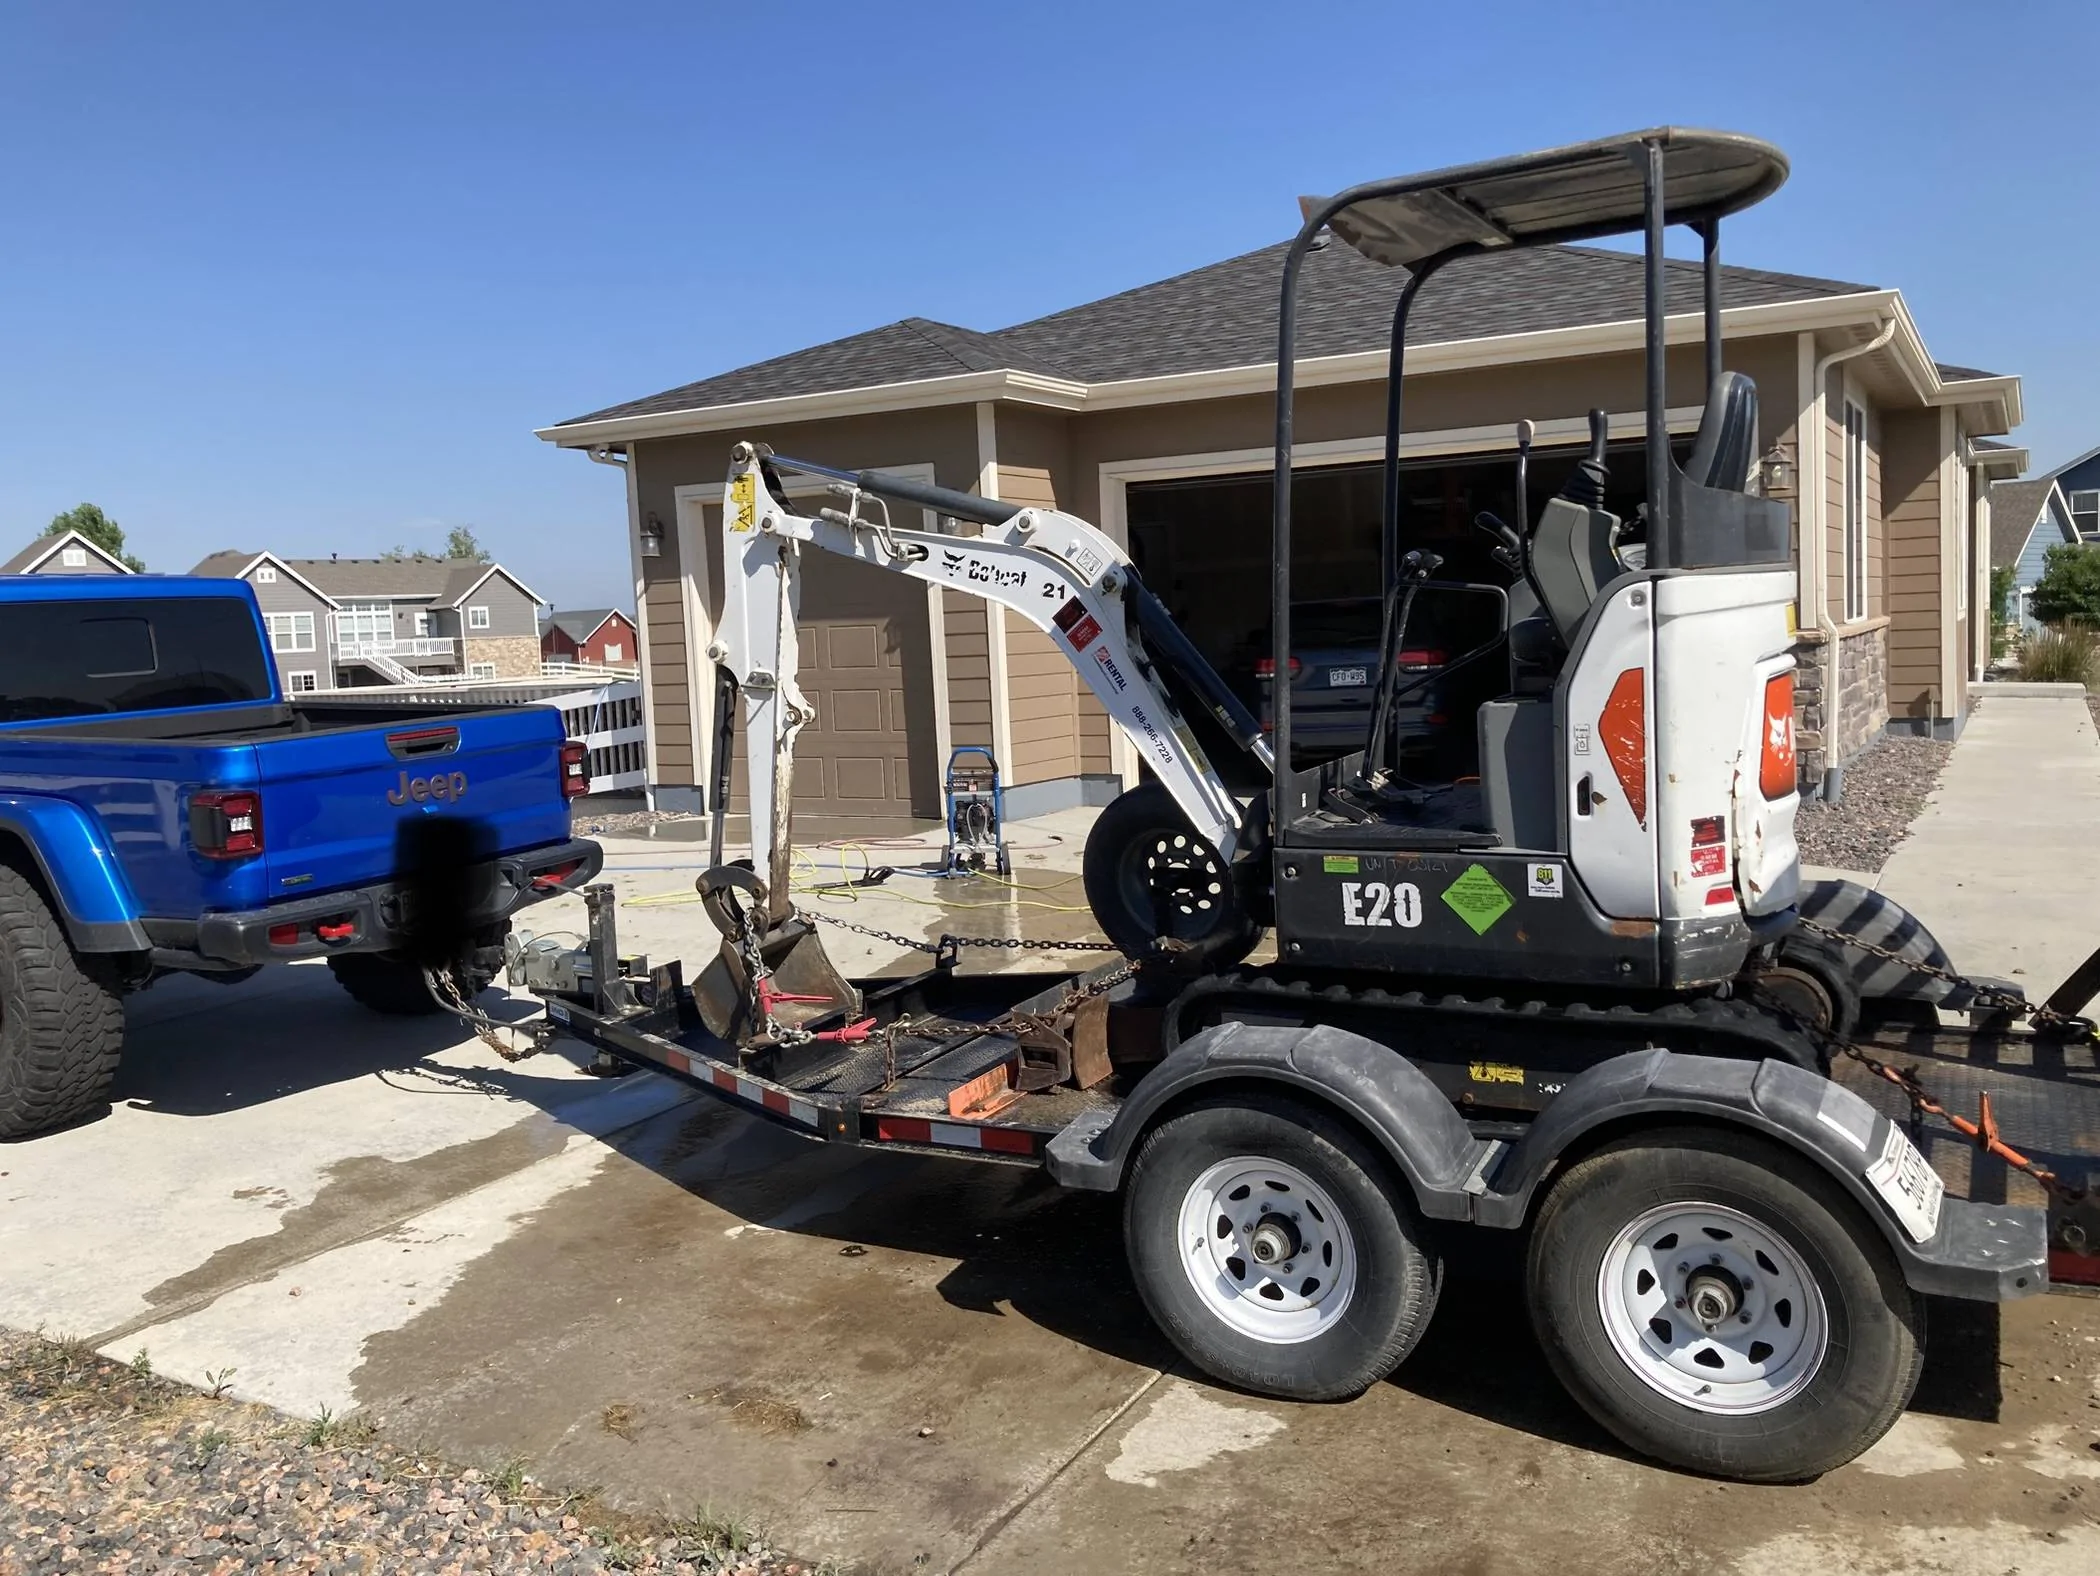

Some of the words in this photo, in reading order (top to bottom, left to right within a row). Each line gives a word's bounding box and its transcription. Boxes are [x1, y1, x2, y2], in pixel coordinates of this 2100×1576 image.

[1042, 582, 1066, 600] 21
[1103, 658, 1128, 692] RENTAL
[1132, 705, 1174, 765] 888-266-7228
[387, 770, 468, 806] Jeep
[1536, 867, 1554, 880] 811
[1341, 882, 1423, 928] E20
